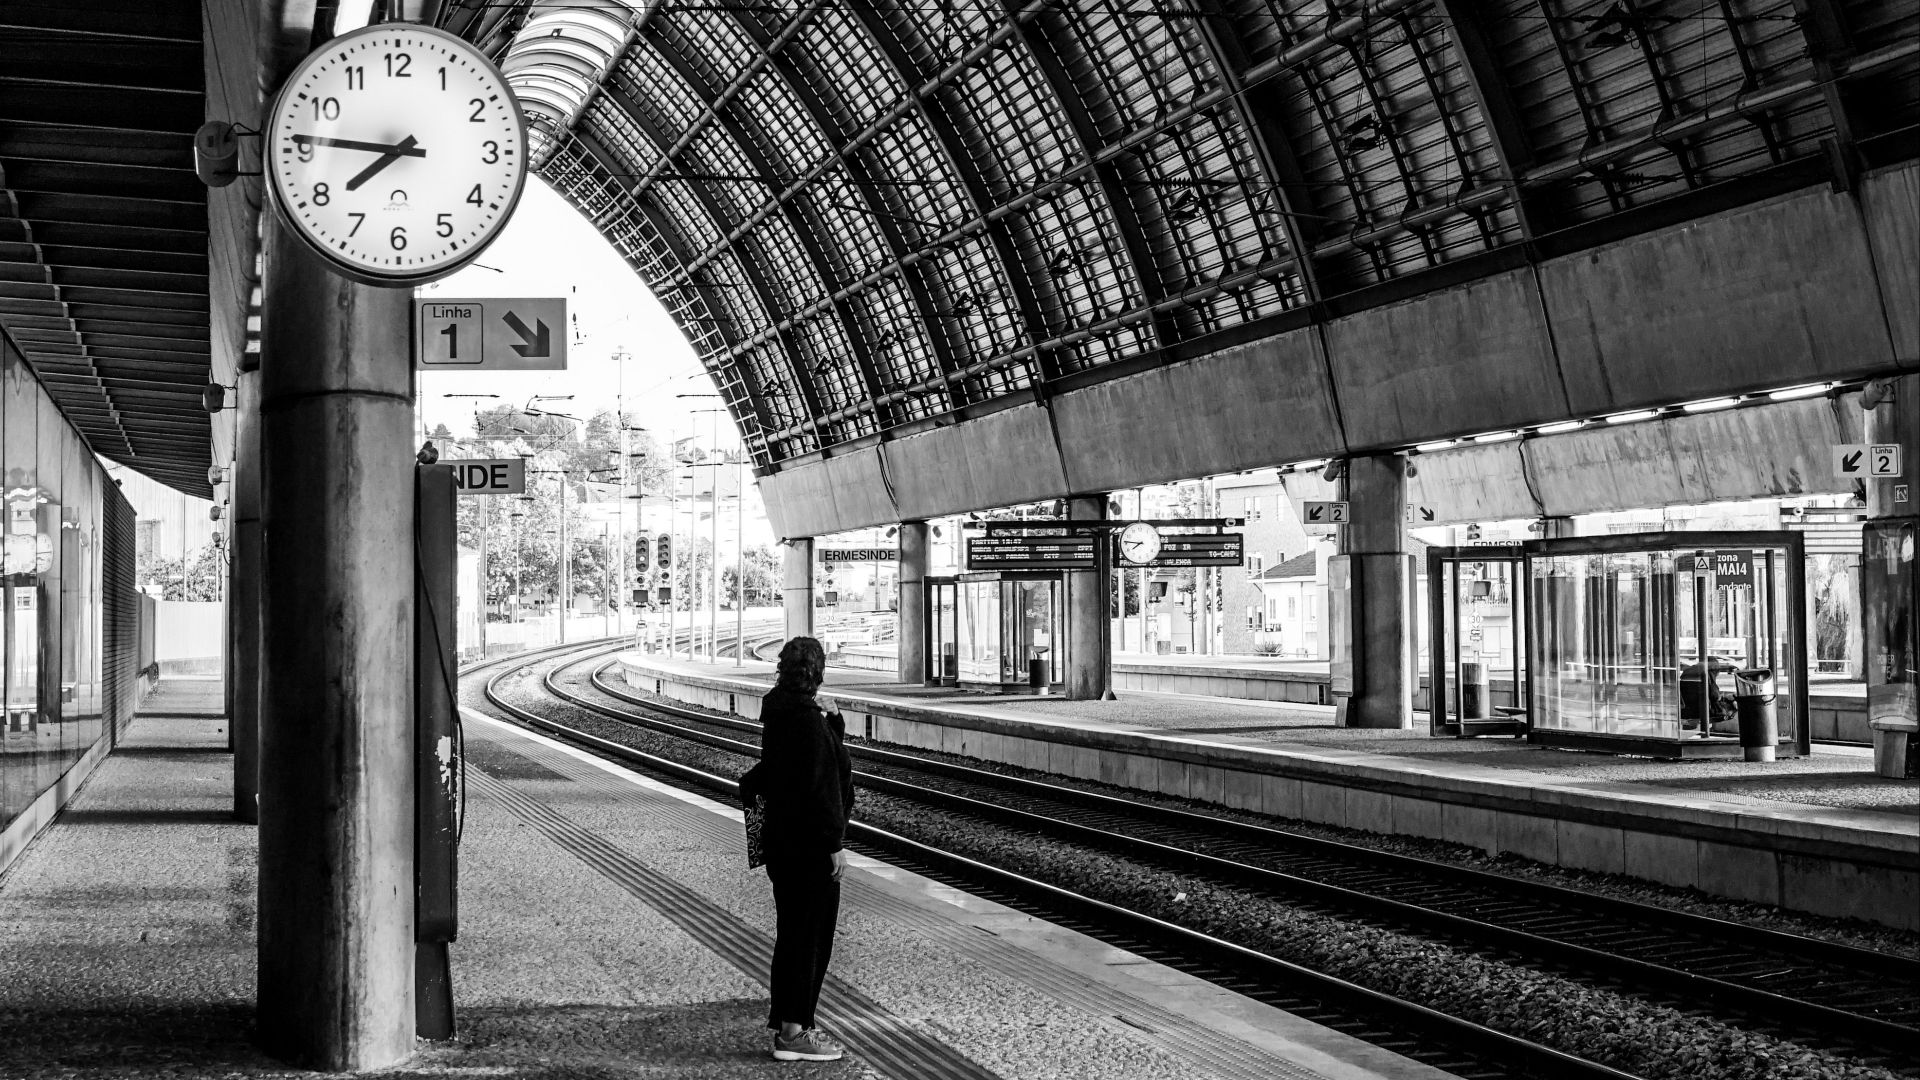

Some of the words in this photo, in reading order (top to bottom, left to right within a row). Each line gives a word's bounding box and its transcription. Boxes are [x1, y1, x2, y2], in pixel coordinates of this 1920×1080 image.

[384, 53, 412, 77] 12
[345, 66, 364, 90] 11
[438, 67, 446, 91] 1
[311, 97, 340, 121] 10
[469, 99, 486, 122] 2
[297, 140, 314, 163] 9
[482, 141, 499, 164] 3
[312, 182, 330, 206] 8
[466, 183, 484, 208] 4
[348, 213, 365, 237] 7
[436, 213, 454, 238] 5
[390, 226, 407, 251] 6
[433, 306, 472, 318] Linha
[441, 324, 457, 359] 1
[1878, 456, 1890, 472] 2
[1333, 510, 1342, 520] 2
[825, 550, 896, 560] ERMESINDE
